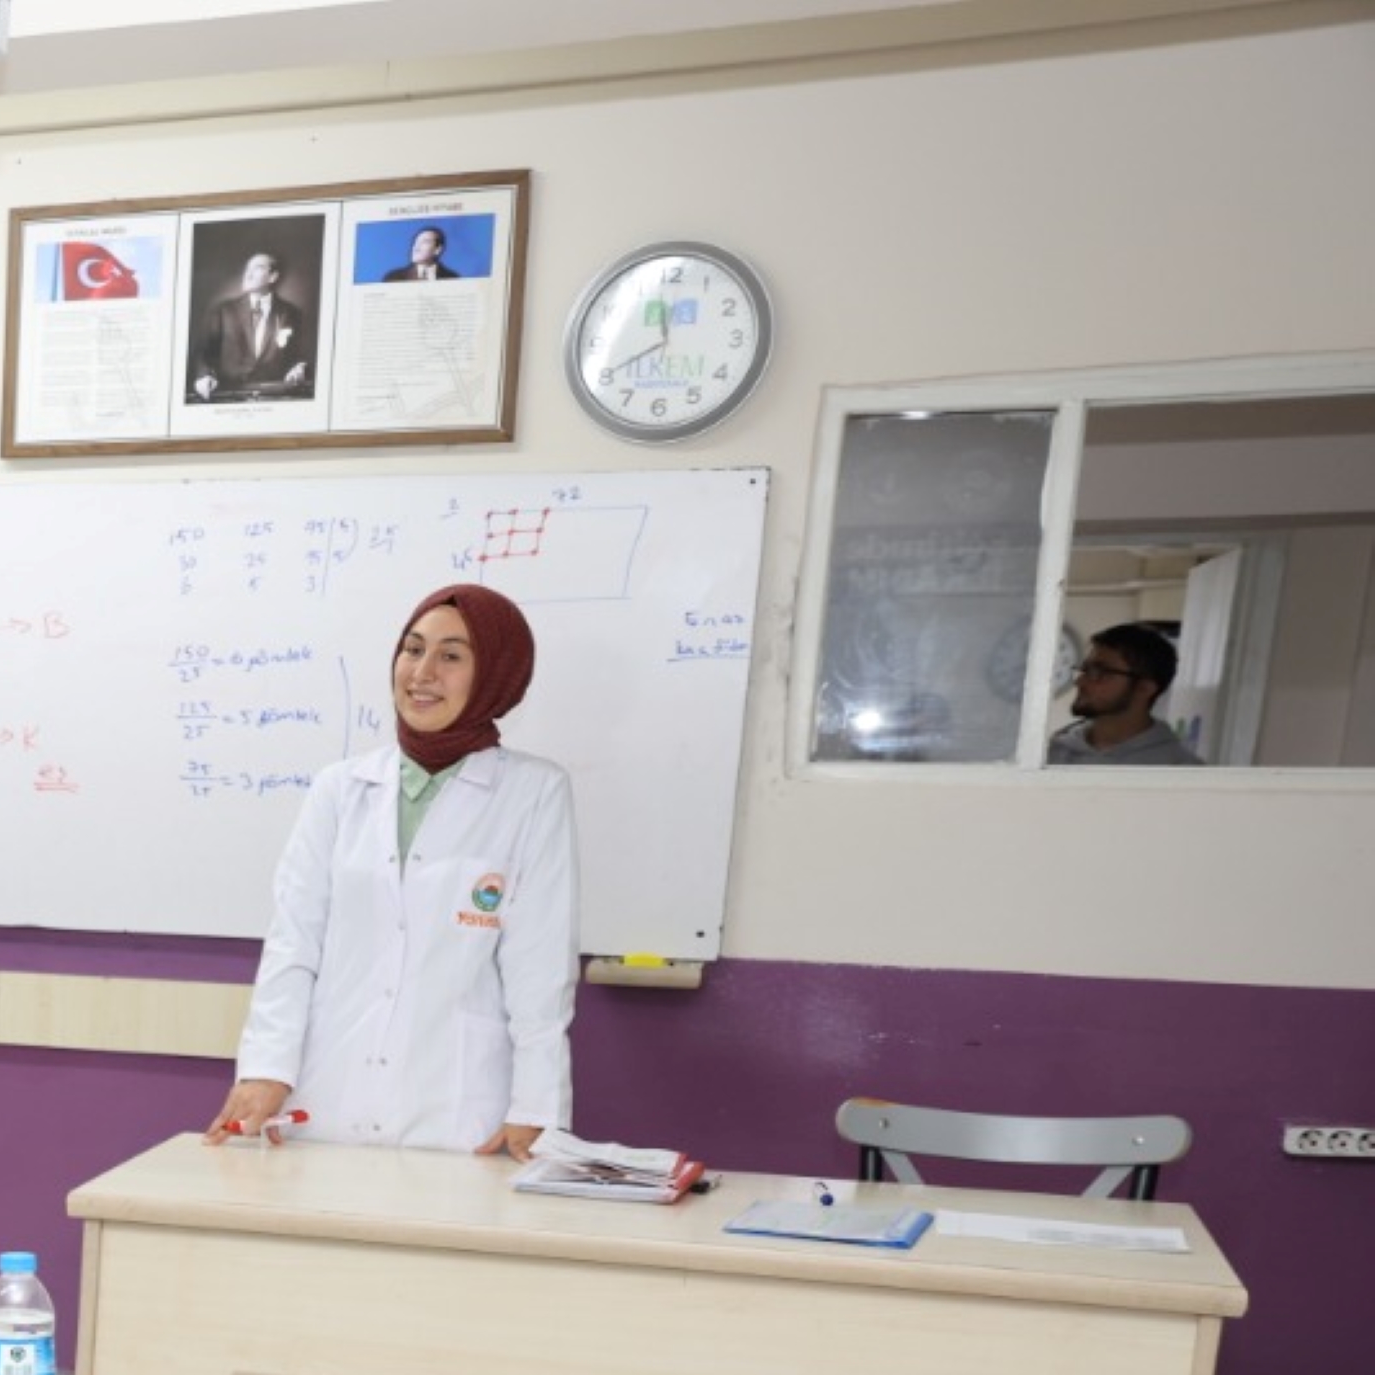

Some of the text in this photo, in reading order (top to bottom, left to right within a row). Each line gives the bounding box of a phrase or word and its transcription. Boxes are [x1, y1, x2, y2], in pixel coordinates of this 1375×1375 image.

[661, 267, 683, 284] 12
[721, 299, 736, 316] 2
[729, 329, 743, 348] 3
[599, 368, 614, 386] 8
[712, 364, 728, 381] 4
[619, 389, 635, 407] 7
[686, 386, 702, 404] 5
[651, 398, 666, 416] 6
[43, 610, 71, 639] B
